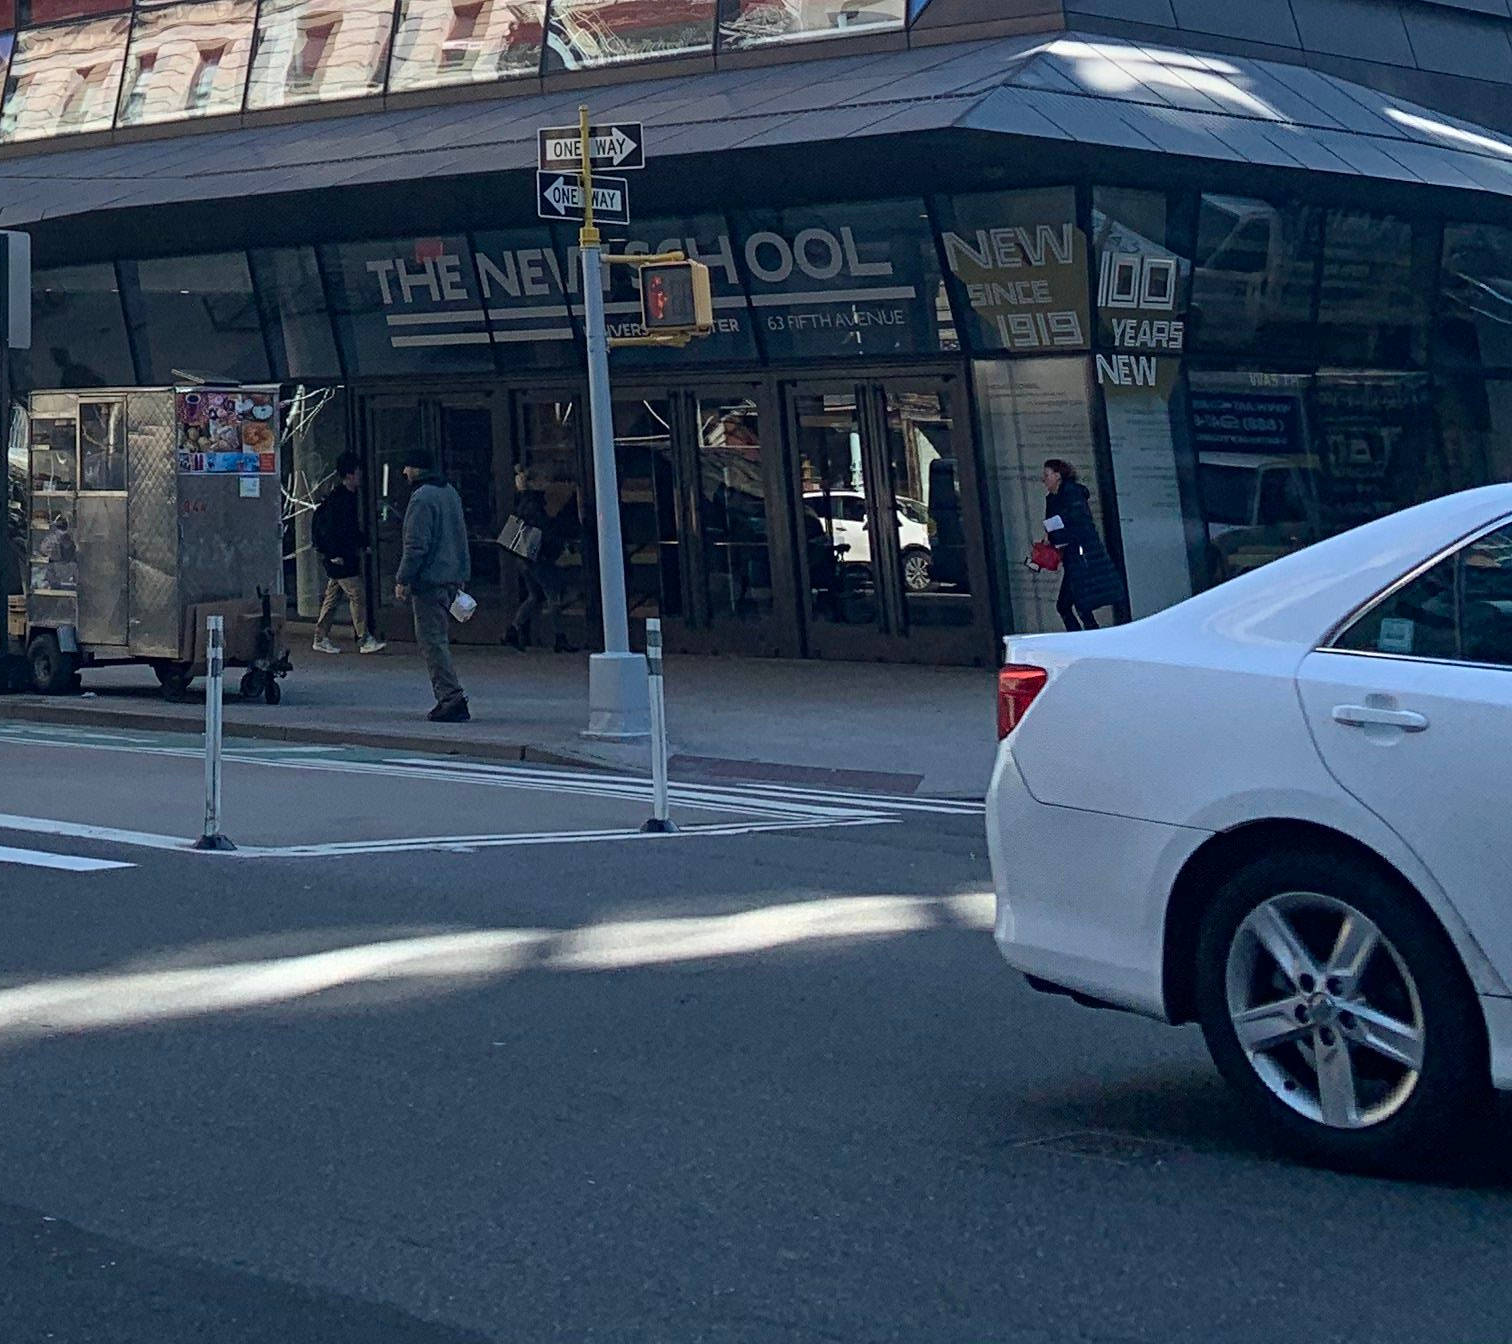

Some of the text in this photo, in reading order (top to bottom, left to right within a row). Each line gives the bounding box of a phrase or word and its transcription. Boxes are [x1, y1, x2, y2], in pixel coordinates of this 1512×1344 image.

[553, 138, 626, 158] ONE WAY
[552, 186, 616, 208] ONE WAY
[941, 223, 1074, 272] NEW
[366, 254, 469, 305] THE
[474, 241, 611, 298] NEW
[1096, 250, 1177, 311] 100
[967, 279, 1053, 307] SINCE
[767, 315, 785, 330] 63
[787, 313, 833, 330] FIFTH
[835, 309, 906, 327] AVENUE
[996, 311, 1084, 348] 1919
[1111, 318, 1185, 349] YEARS
[1095, 353, 1157, 387] NEW
